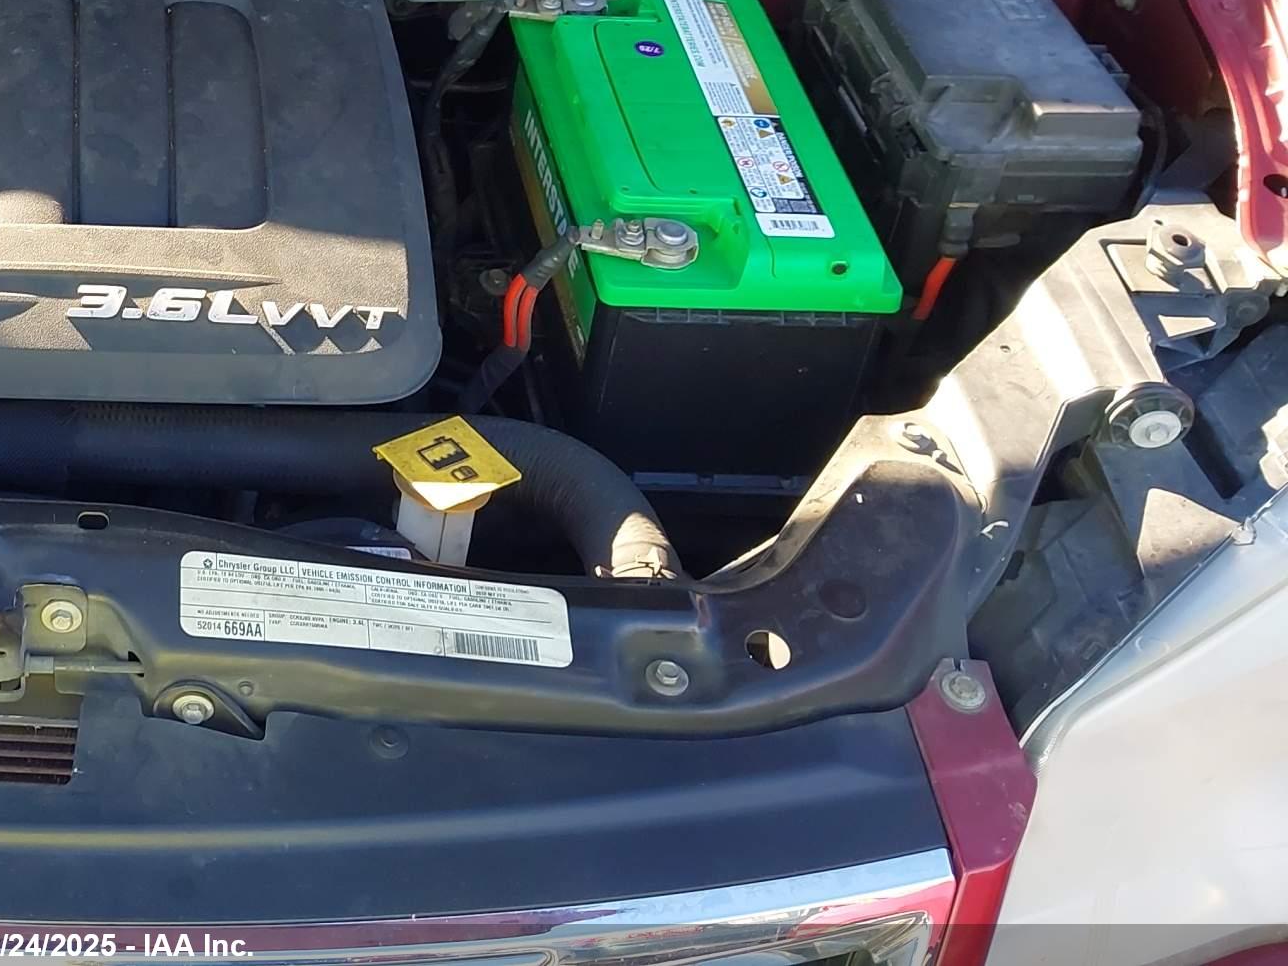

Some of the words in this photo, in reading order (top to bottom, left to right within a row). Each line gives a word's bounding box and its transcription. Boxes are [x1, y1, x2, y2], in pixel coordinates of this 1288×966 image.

[524, 110, 578, 278] INTERSTAE
[66, 283, 259, 325] 3.6L
[261, 300, 399, 330] VVT
[218, 559, 251, 571] Chrysler
[253, 562, 277, 574] Group
[280, 564, 295, 575] LLC
[302, 567, 334, 579] VEHICLE
[336, 571, 373, 584] EMISSION
[375, 576, 412, 588] CONTROL
[413, 579, 467, 593] INFORMATION
[197, 620, 222, 631] 52014
[224, 620, 262, 638] 669AA
